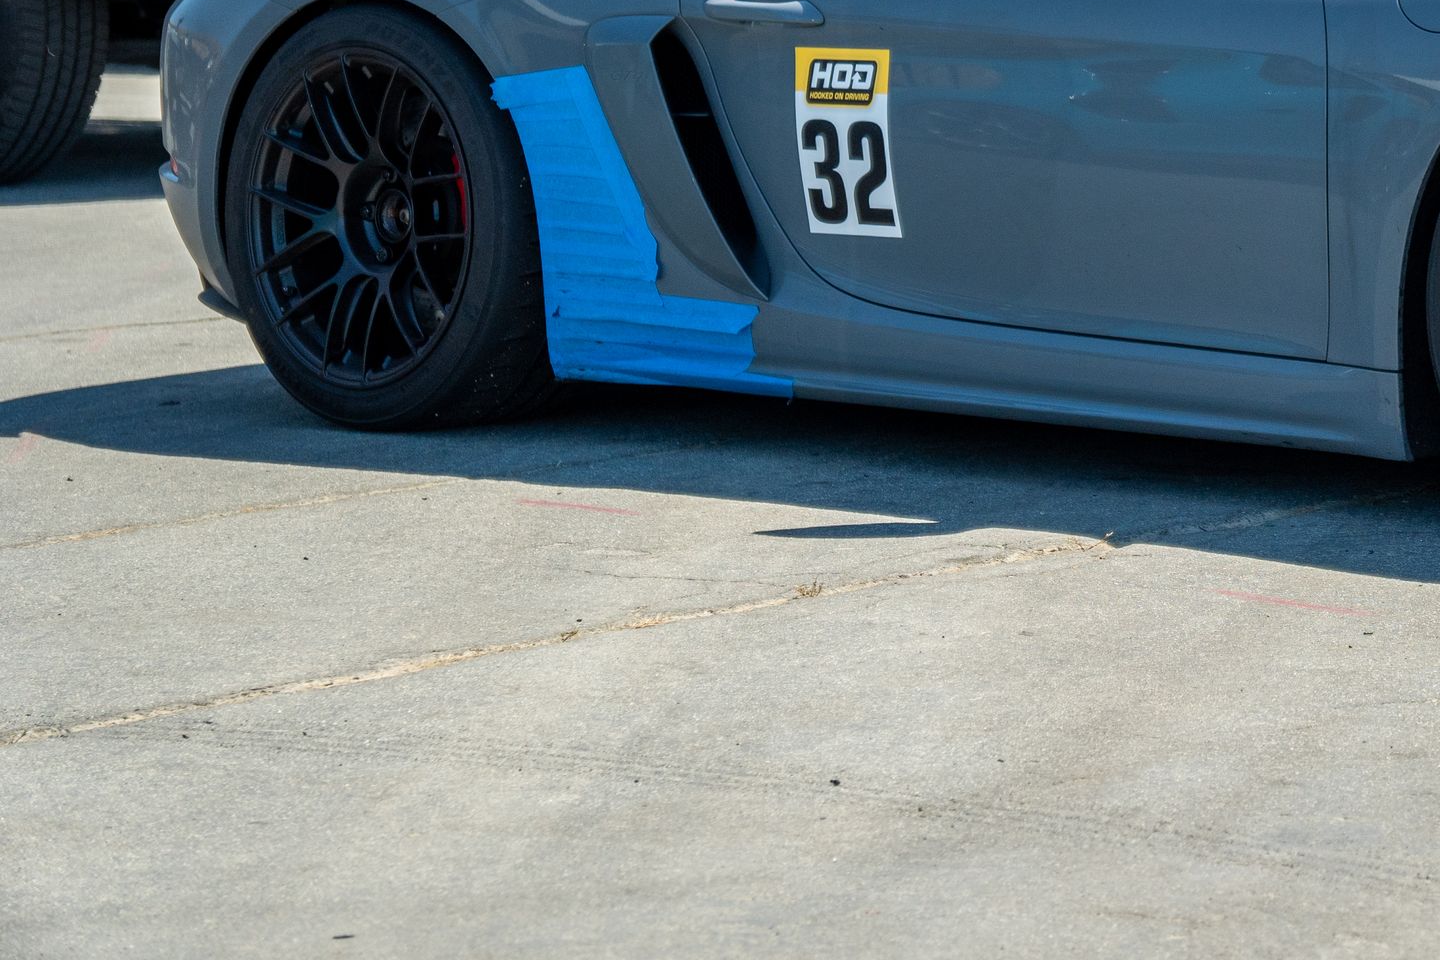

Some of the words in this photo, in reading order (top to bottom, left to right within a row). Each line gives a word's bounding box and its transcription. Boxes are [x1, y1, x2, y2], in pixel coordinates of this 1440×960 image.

[811, 62, 875, 90] HOD
[809, 92, 833, 100] HOOKED
[834, 92, 844, 100] ON
[845, 92, 870, 101] DRIVING
[802, 118, 896, 226] 32
